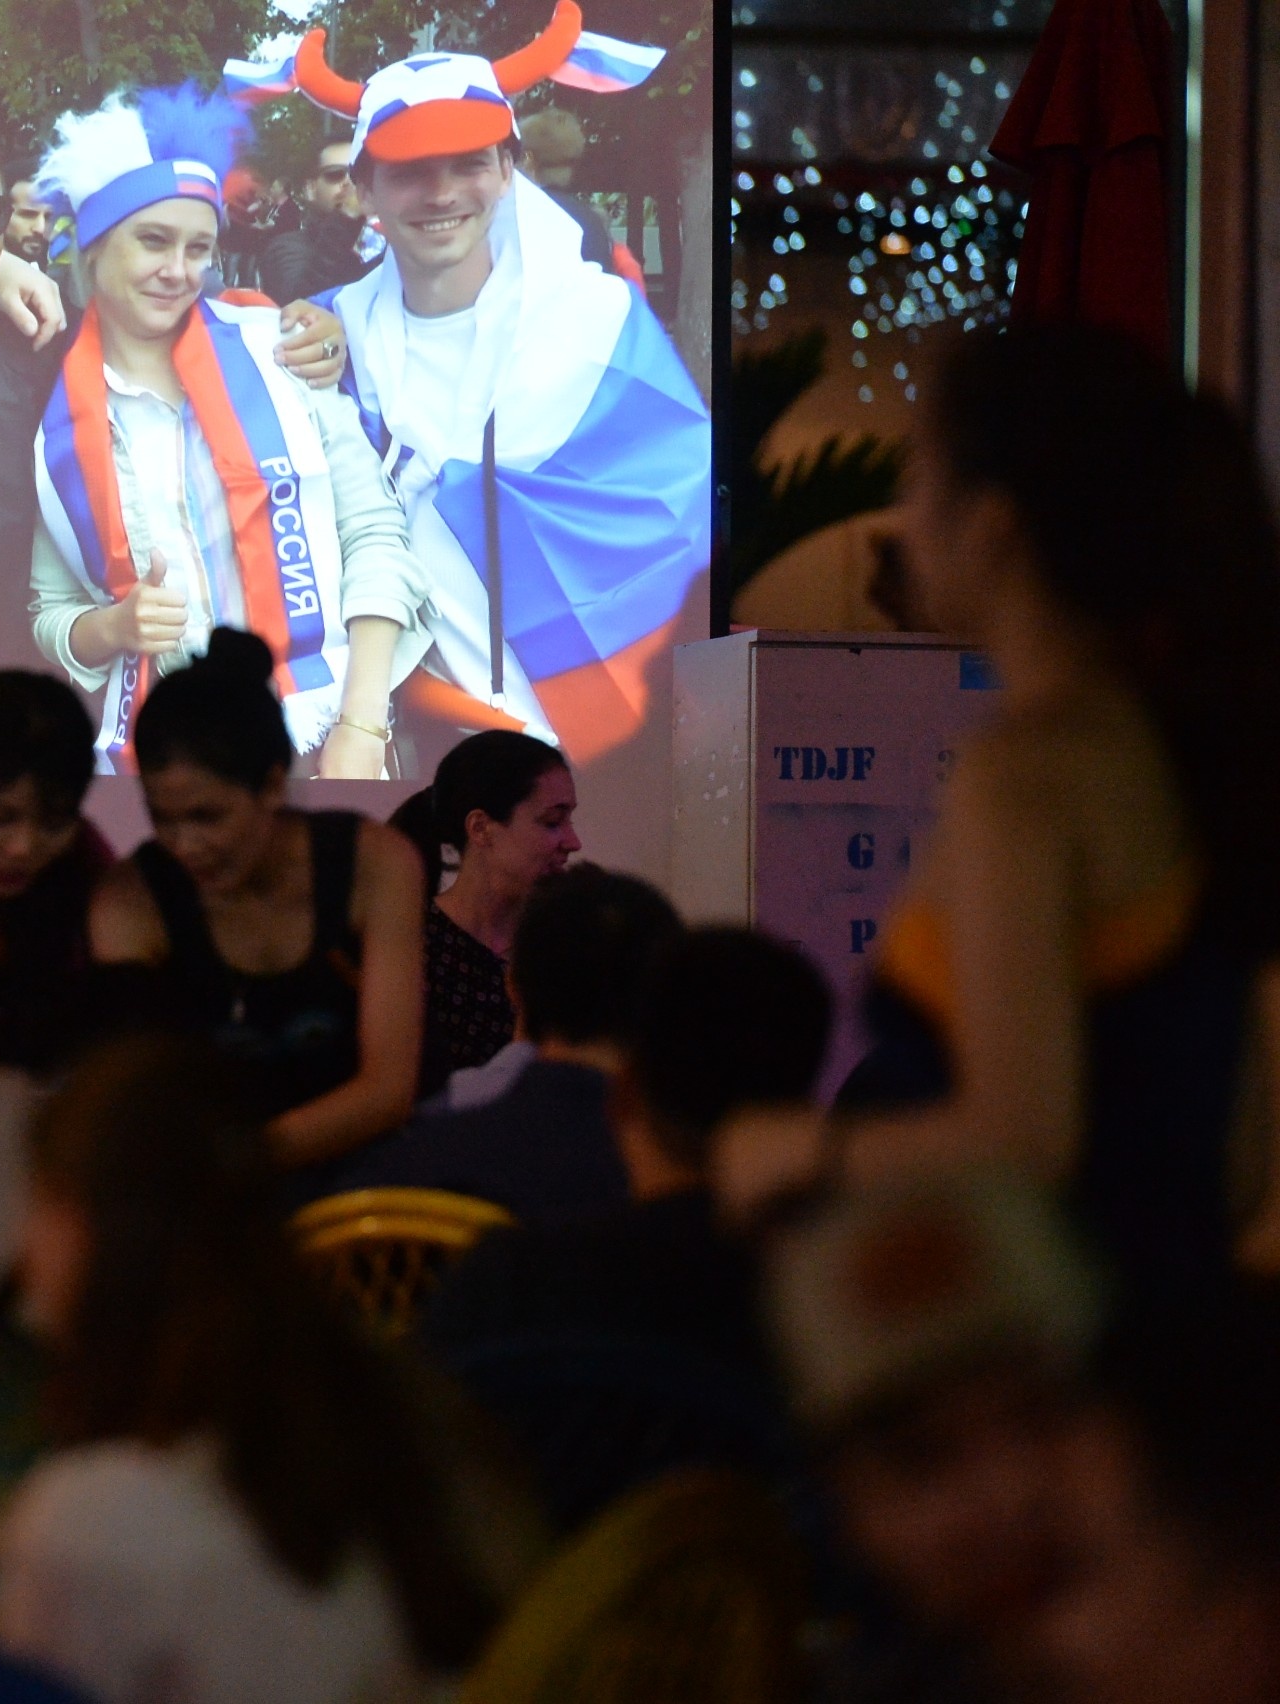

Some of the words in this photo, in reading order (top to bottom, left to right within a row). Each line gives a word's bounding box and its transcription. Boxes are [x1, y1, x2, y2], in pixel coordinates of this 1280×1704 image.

[259, 456, 320, 619] РОССИЯ
[773, 747, 875, 781] TDJF
[847, 833, 875, 870] G
[849, 919, 877, 954] P
